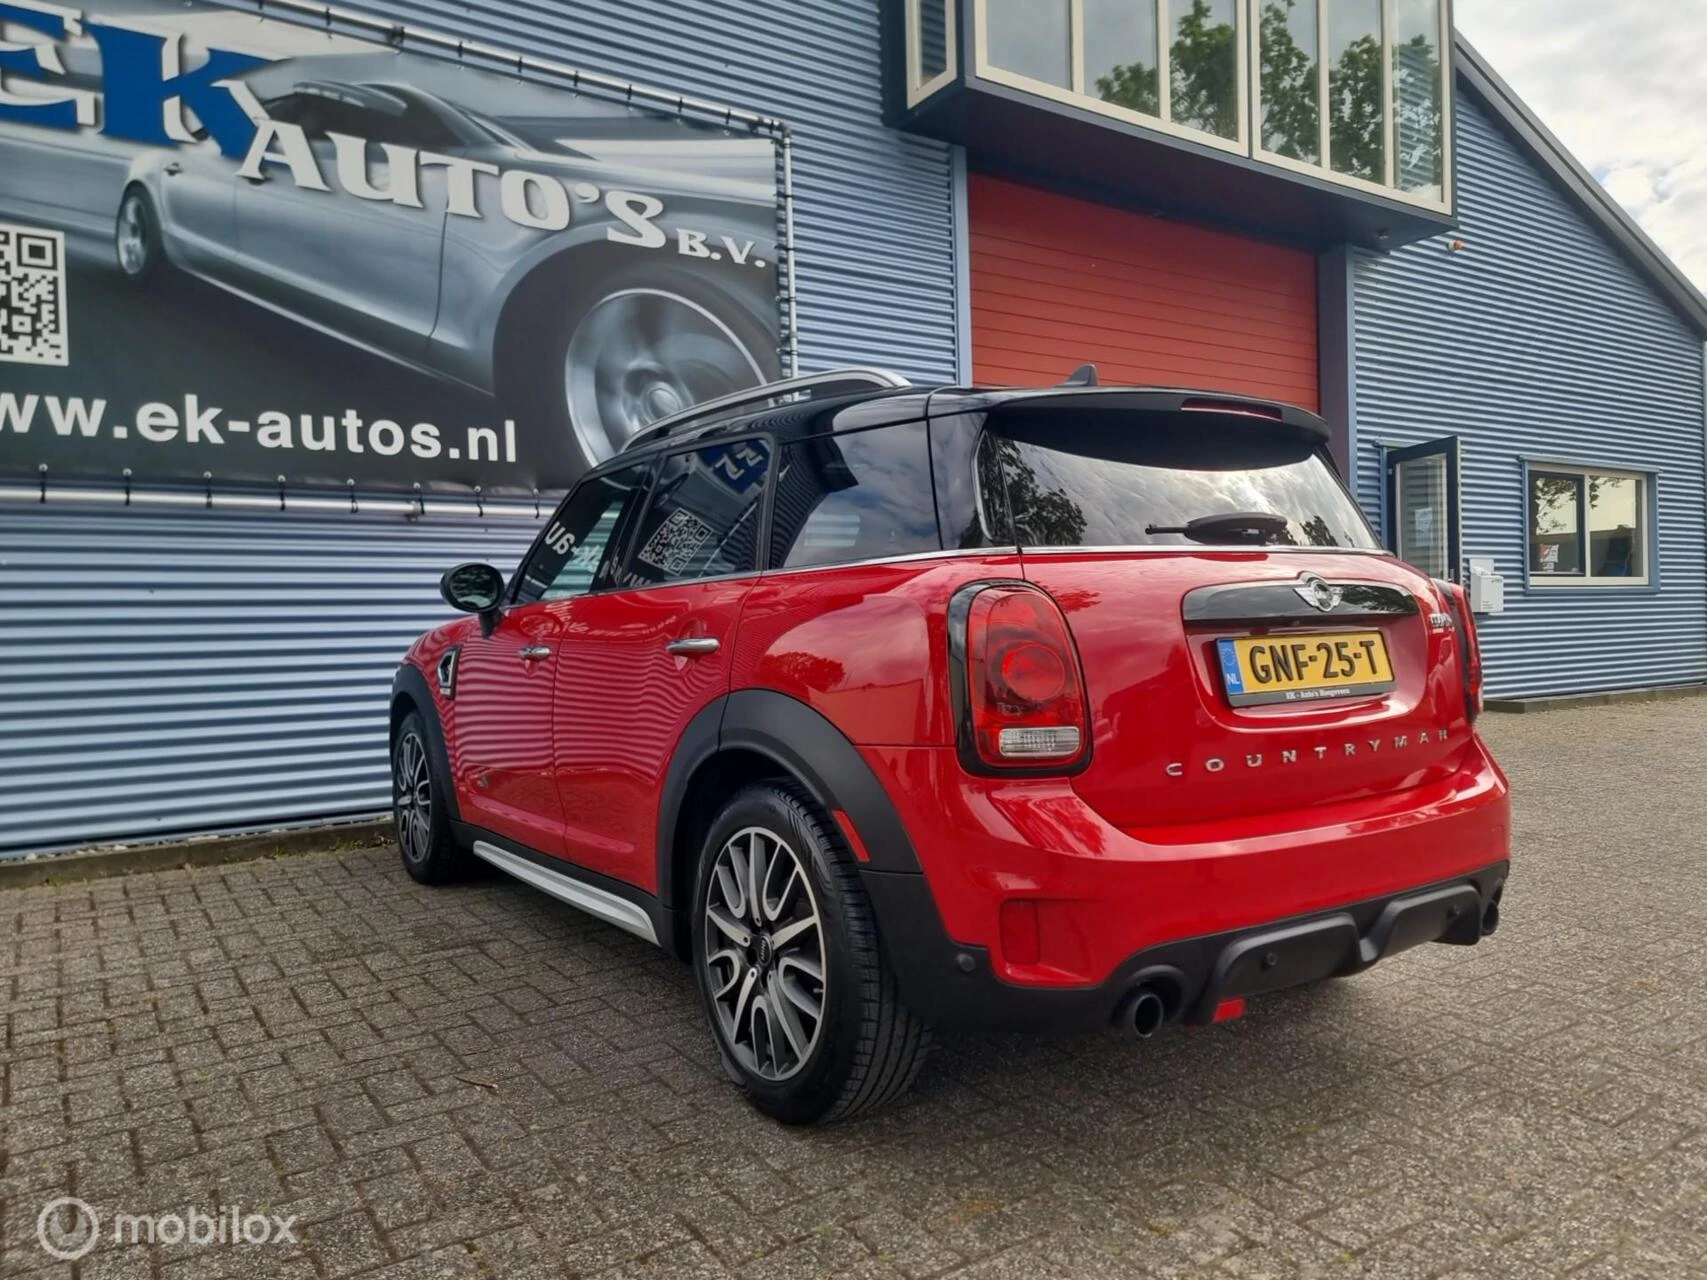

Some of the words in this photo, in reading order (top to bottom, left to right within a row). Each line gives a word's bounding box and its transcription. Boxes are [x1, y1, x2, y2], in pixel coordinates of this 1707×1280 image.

[676, 227, 767, 268] B.V.
[1226, 672, 1240, 685] NL
[1249, 639, 1378, 684] GNF-25-T
[1165, 729, 1448, 777] COUNTRYMAN
